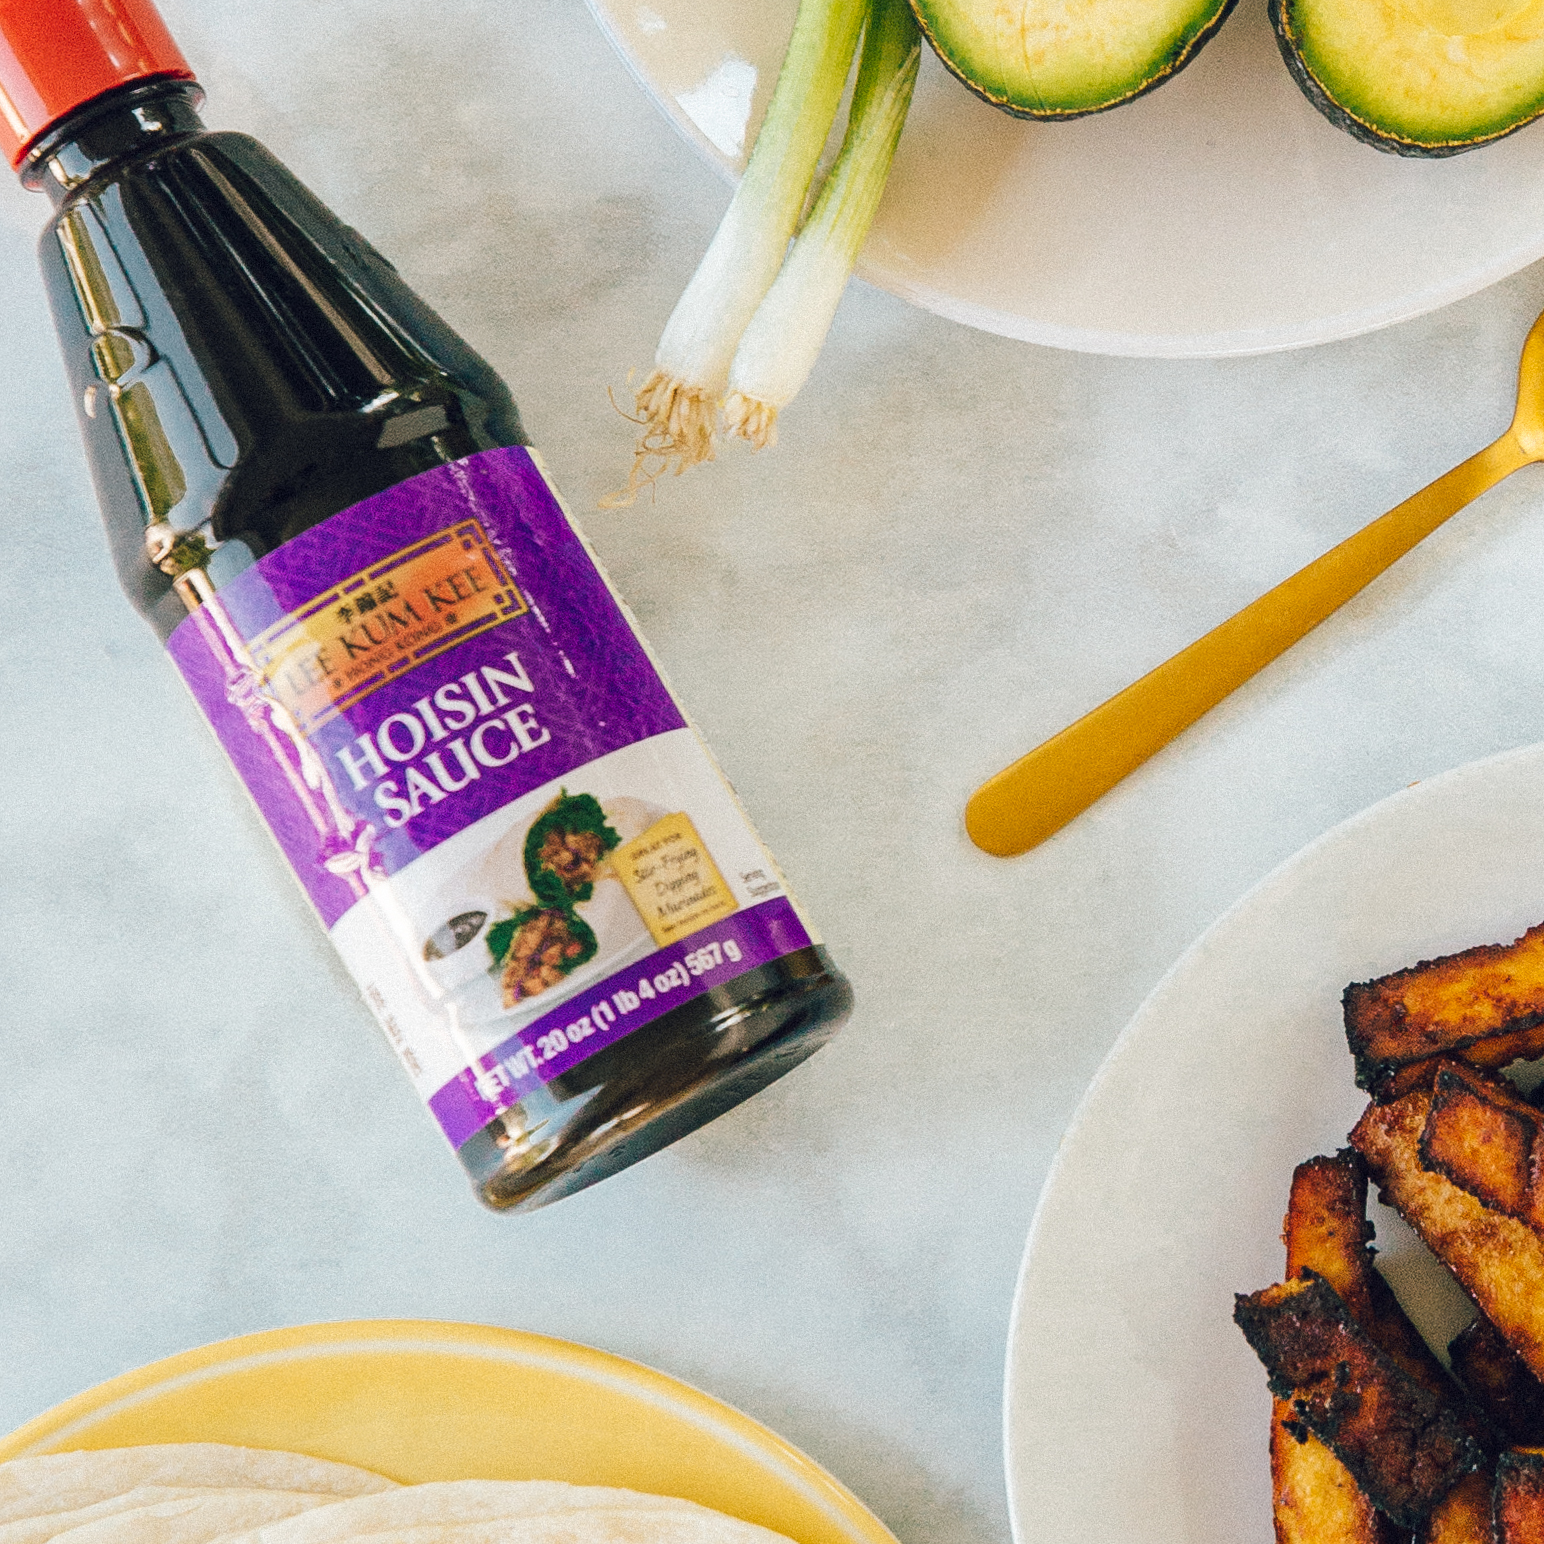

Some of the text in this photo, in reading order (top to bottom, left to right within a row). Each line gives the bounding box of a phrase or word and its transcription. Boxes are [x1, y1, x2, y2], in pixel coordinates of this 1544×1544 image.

[285, 564, 487, 696] LEE KUM KEE
[335, 651, 536, 791] HOISIN
[373, 703, 552, 829] SAUCE
[503, 1043, 545, 1080] WT.
[536, 1027, 570, 1061] 20
[565, 1014, 598, 1044] oz
[590, 998, 617, 1032] (1
[610, 988, 642, 1016] lb
[638, 977, 657, 1000] 4
[653, 960, 691, 995] oz)
[684, 941, 724, 977] 567
[722, 938, 744, 963] g
